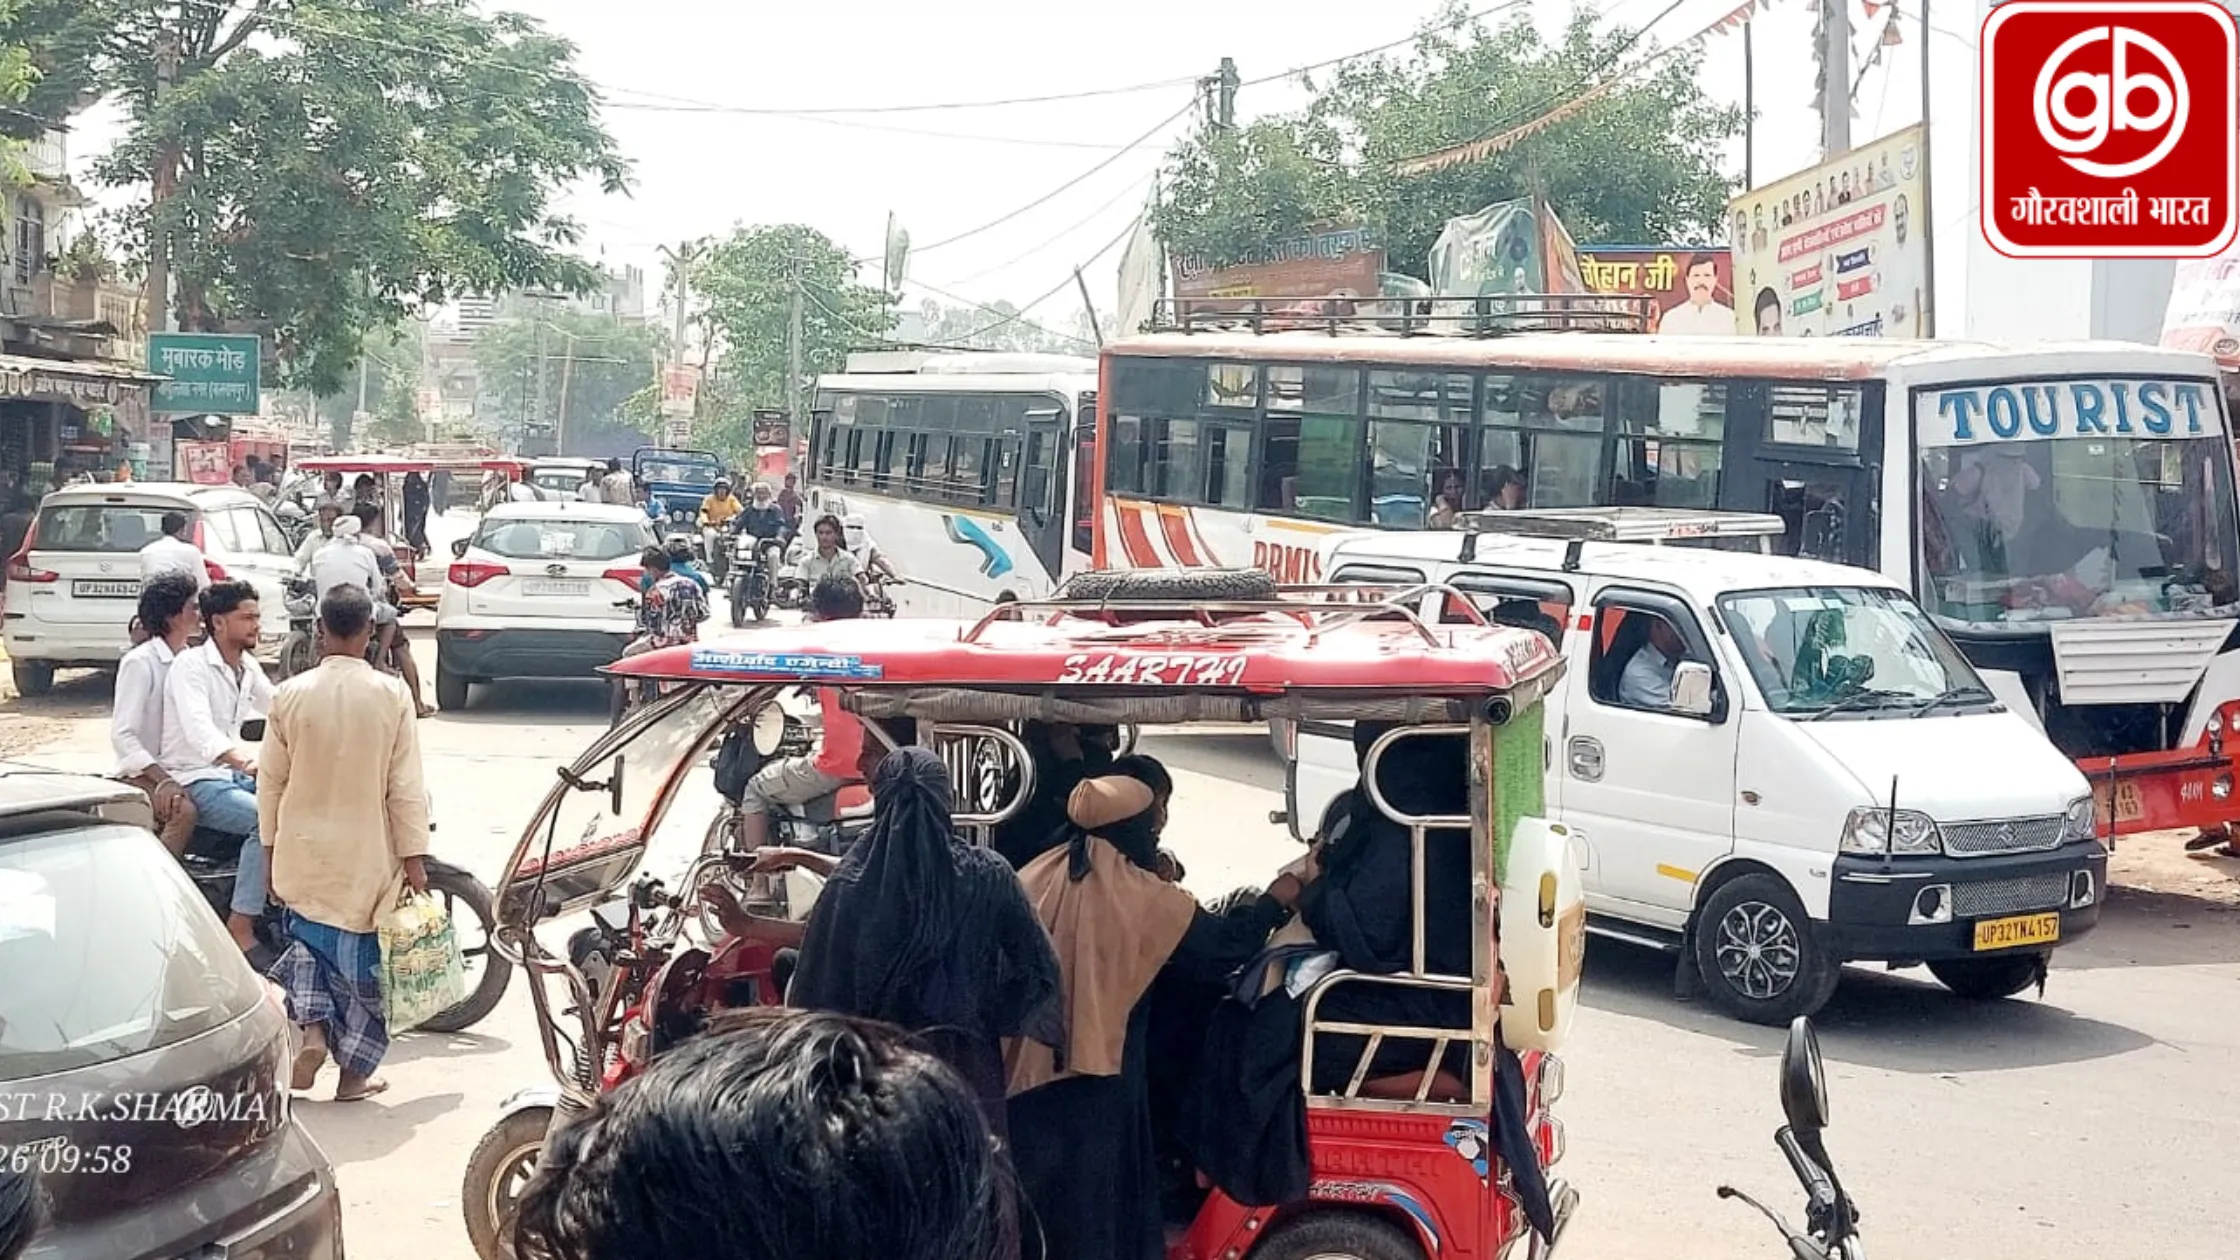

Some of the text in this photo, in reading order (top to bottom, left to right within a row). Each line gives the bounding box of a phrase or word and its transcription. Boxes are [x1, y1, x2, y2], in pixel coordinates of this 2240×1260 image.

[1643, 254, 1677, 291] जी
[161, 343, 246, 374] मुबारक मोड़
[1938, 382, 2204, 440] TOURIST
[1057, 654, 1247, 686] SAARTHI
